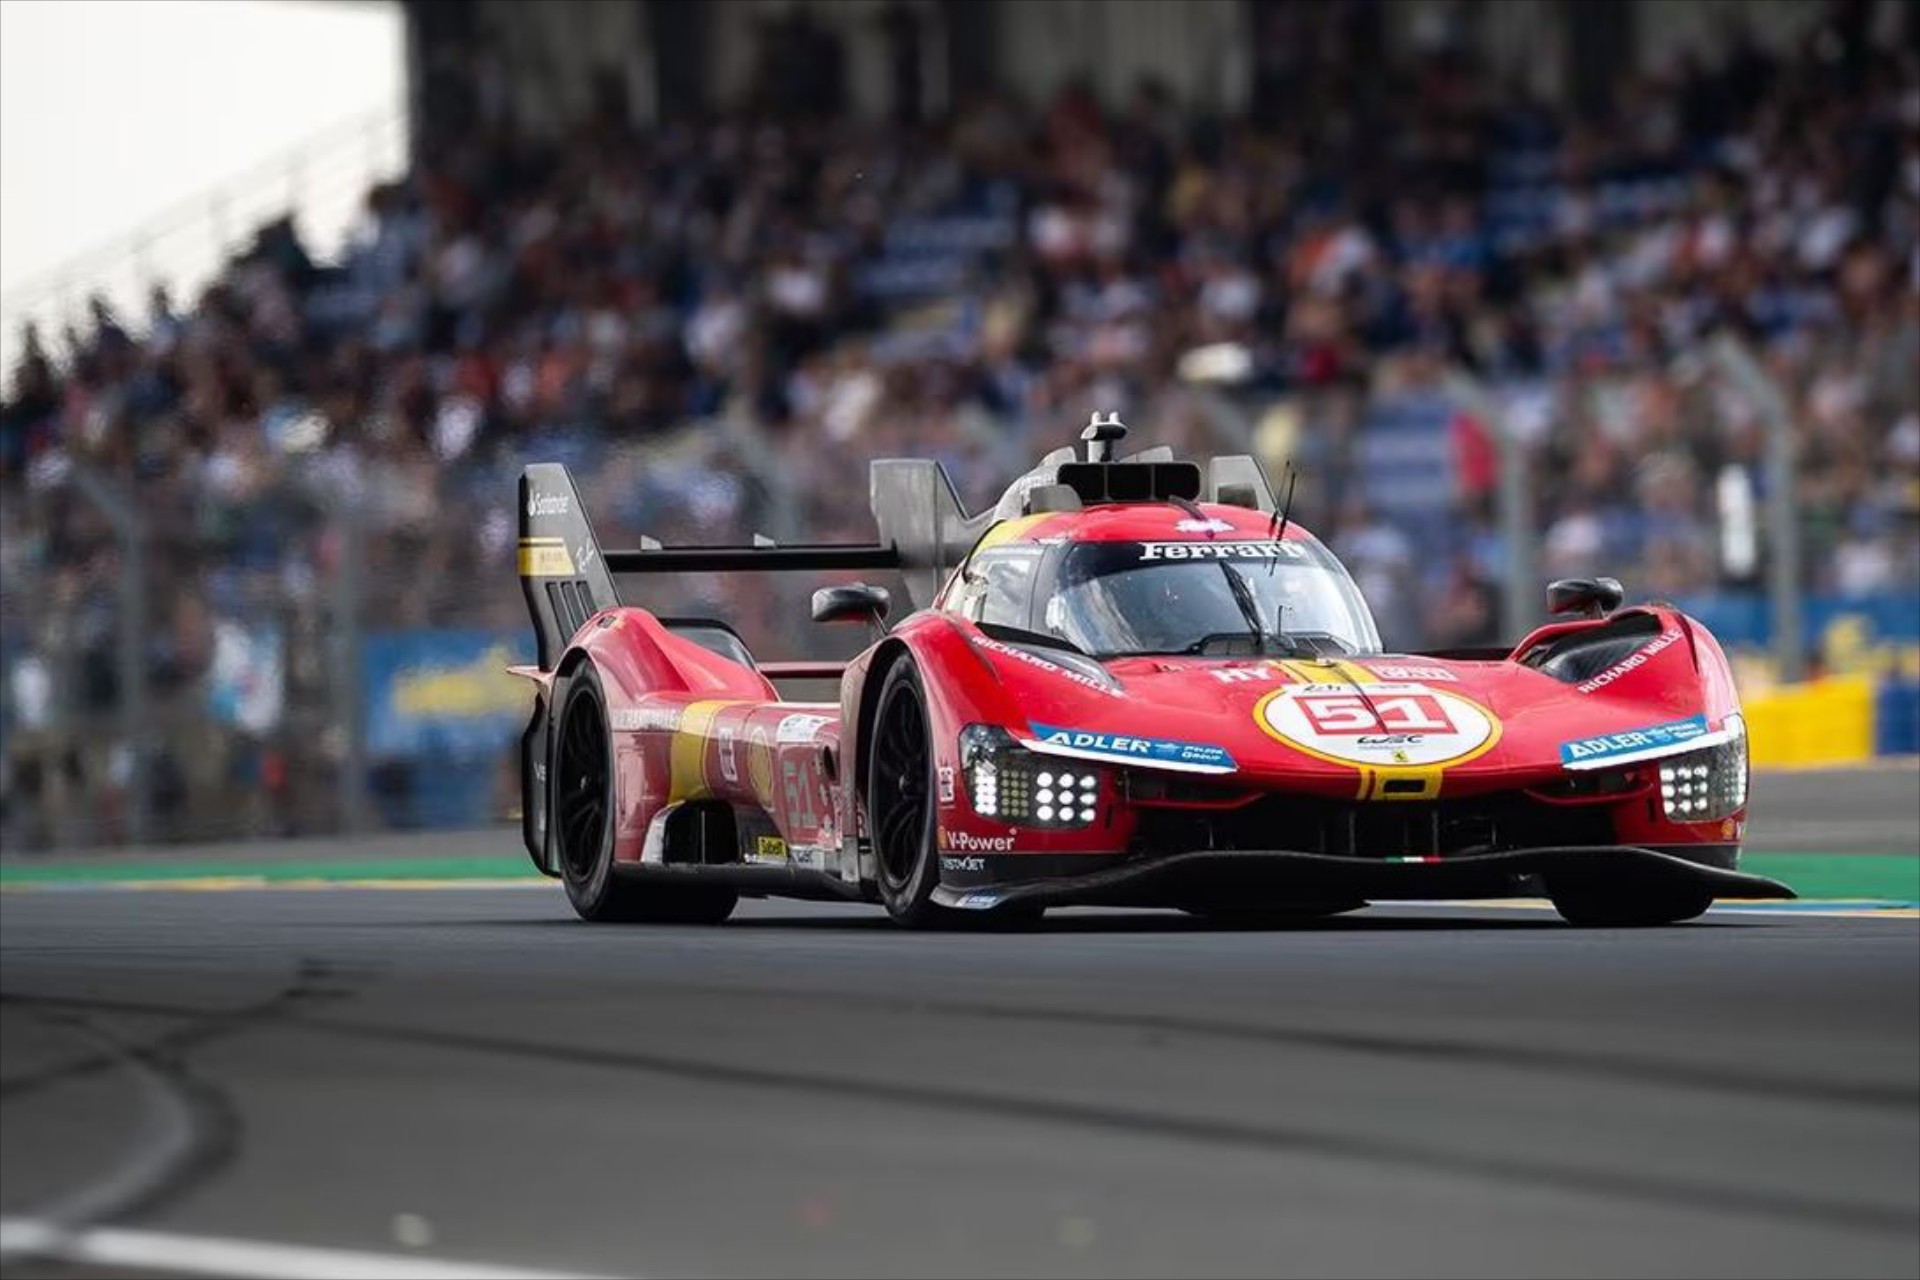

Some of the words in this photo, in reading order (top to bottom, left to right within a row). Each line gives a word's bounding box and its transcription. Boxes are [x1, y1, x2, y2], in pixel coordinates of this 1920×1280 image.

[1138, 541, 1307, 561] Ferrari
[971, 635, 1059, 672] RICHARD
[1062, 669, 1126, 698] MILLE
[1578, 653, 1648, 694] RICHARD
[1642, 628, 1683, 656] MILLE
[1210, 666, 1271, 683] HY
[1302, 698, 1447, 729] 51
[1045, 731, 1152, 753] ADLER
[1569, 732, 1652, 758] ADLER
[783, 760, 818, 828] 51
[947, 831, 1015, 851] V-Power
